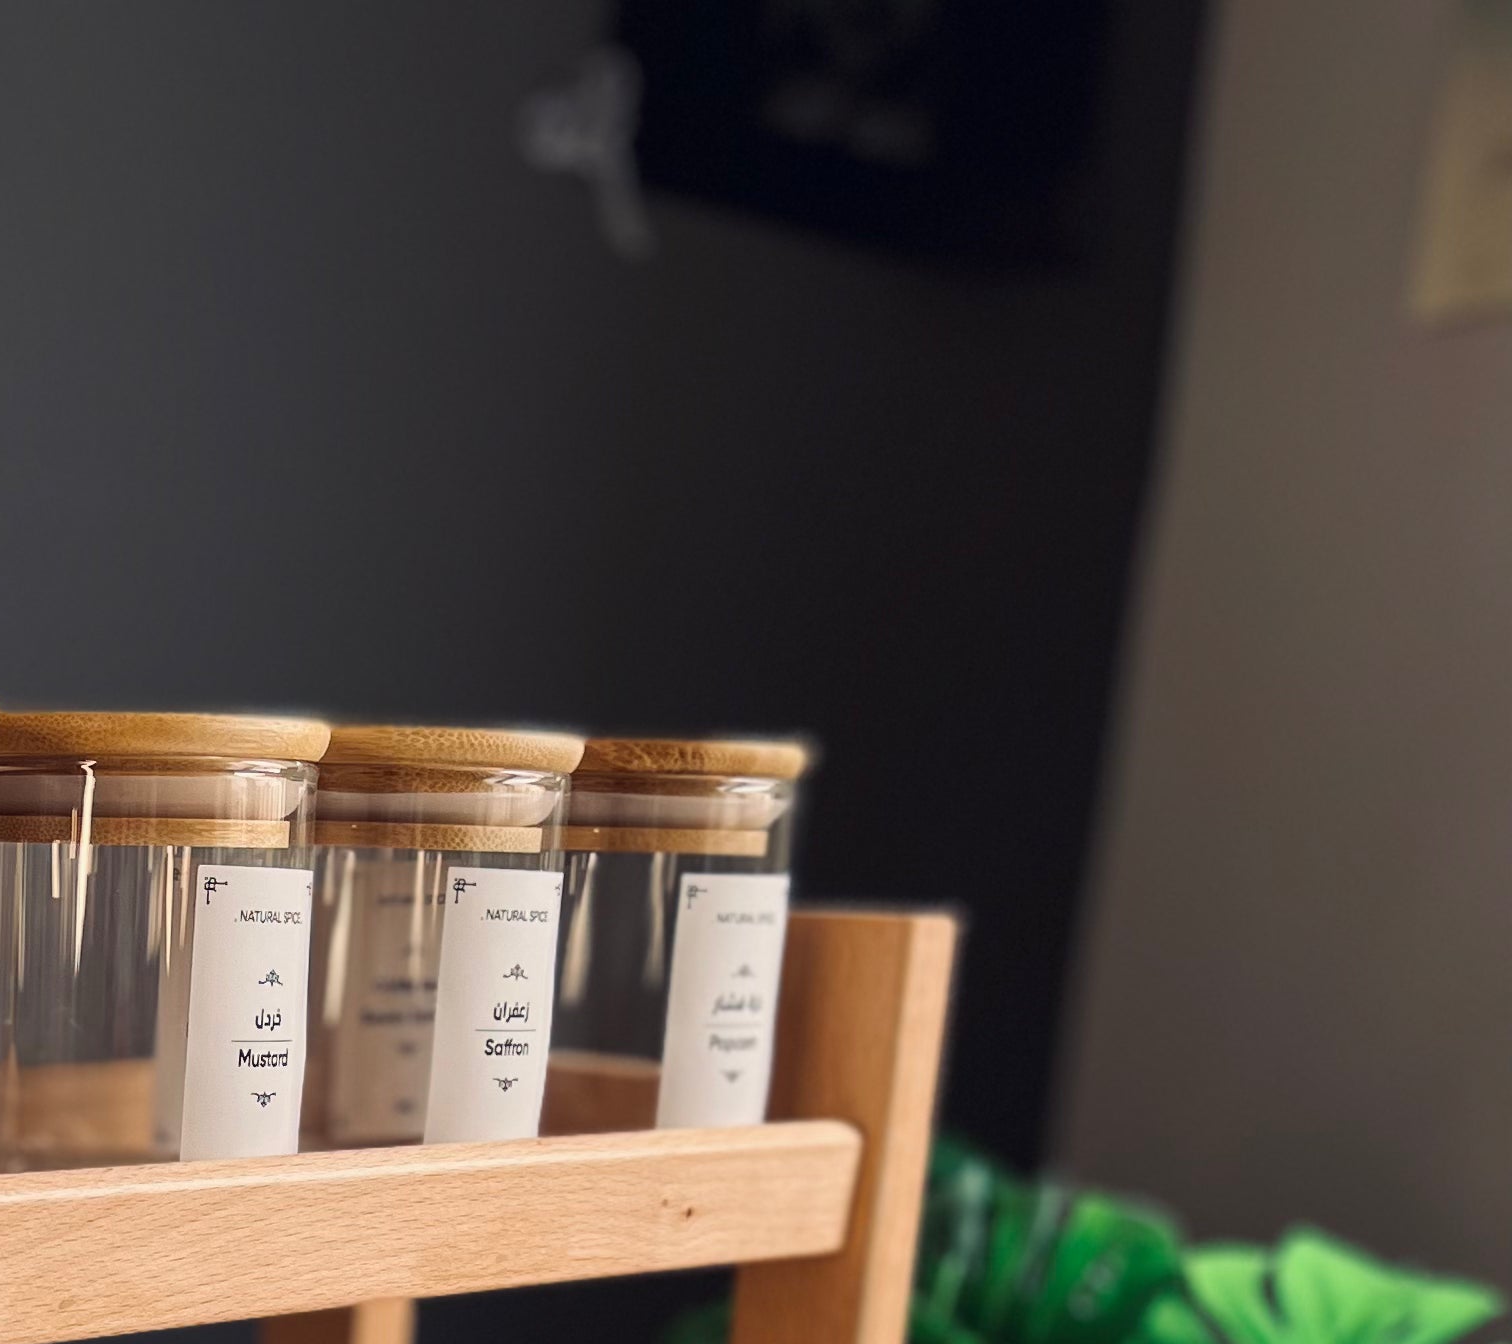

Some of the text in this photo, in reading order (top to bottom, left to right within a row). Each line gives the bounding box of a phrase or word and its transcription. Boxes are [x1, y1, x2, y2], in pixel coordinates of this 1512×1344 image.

[239, 909, 282, 924] NATURAL
[255, 1008, 282, 1032] خردل
[493, 1000, 530, 1023] زعفران
[238, 1047, 289, 1068] Mustard
[484, 1037, 529, 1057] Saffron
